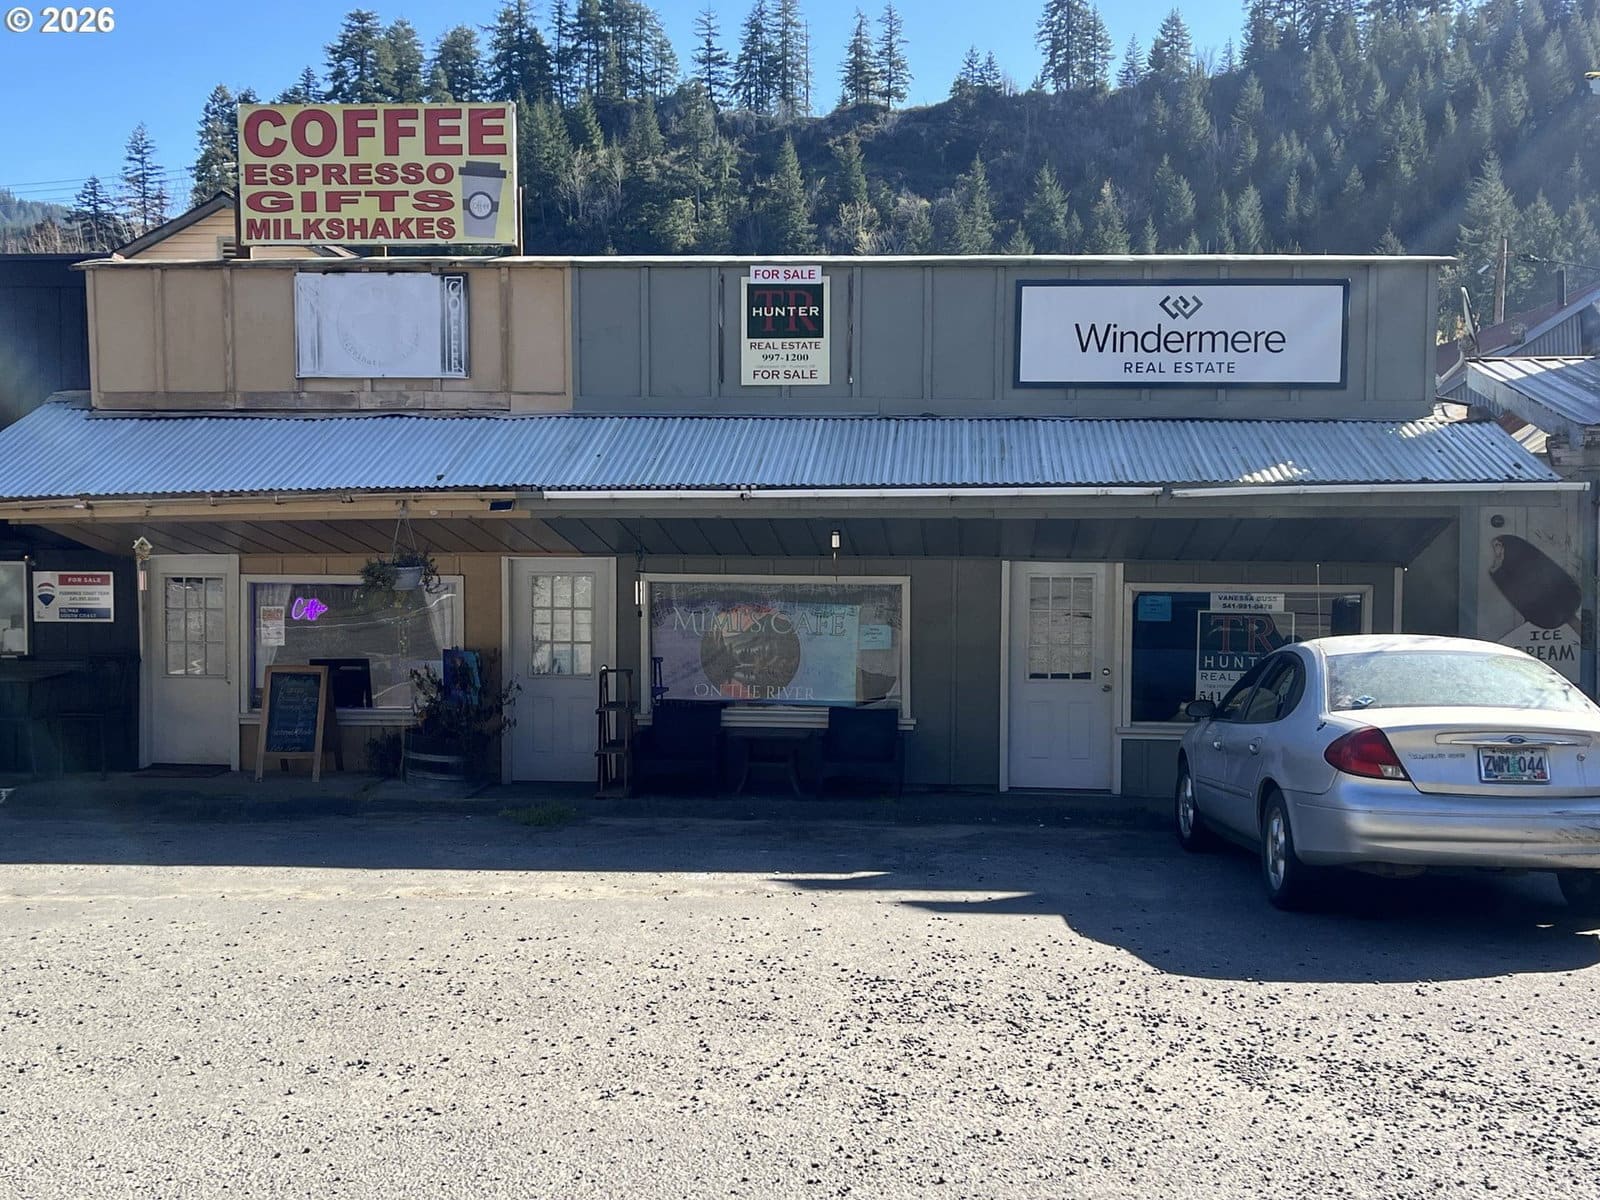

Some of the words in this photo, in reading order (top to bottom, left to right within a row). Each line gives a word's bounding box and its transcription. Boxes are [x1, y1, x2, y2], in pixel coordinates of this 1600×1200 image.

[243, 108, 508, 158] COFFEE
[244, 162, 455, 186] ESPRESSO
[246, 190, 456, 213] GIFTS
[246, 217, 456, 240] MILKSHAKES
[754, 269, 780, 280] FOR
[783, 269, 816, 280] SALE
[752, 306, 820, 317] HUNTER
[753, 290, 819, 331] TR
[750, 342, 778, 350] REAL
[781, 342, 821, 350] ESTATE
[1074, 323, 1287, 354] Windermere
[762, 353, 809, 362] 997-1200
[753, 369, 780, 380] FOR
[783, 369, 818, 380] SALE
[1123, 361, 1166, 373] REAL
[1174, 361, 1236, 373] ESTATE
[672, 607, 762, 636] MIMI'S
[1530, 630, 1563, 641] ICE
[1514, 645, 1576, 661] REAM
[1204, 656, 1265, 668] HUNT
[1200, 672, 1235, 681] REAL
[694, 683, 721, 698] ON
[728, 684, 761, 699] THE
[766, 685, 815, 699] RIVER
[1483, 755, 1511, 773] ZWM
[1518, 755, 1544, 773] 044
